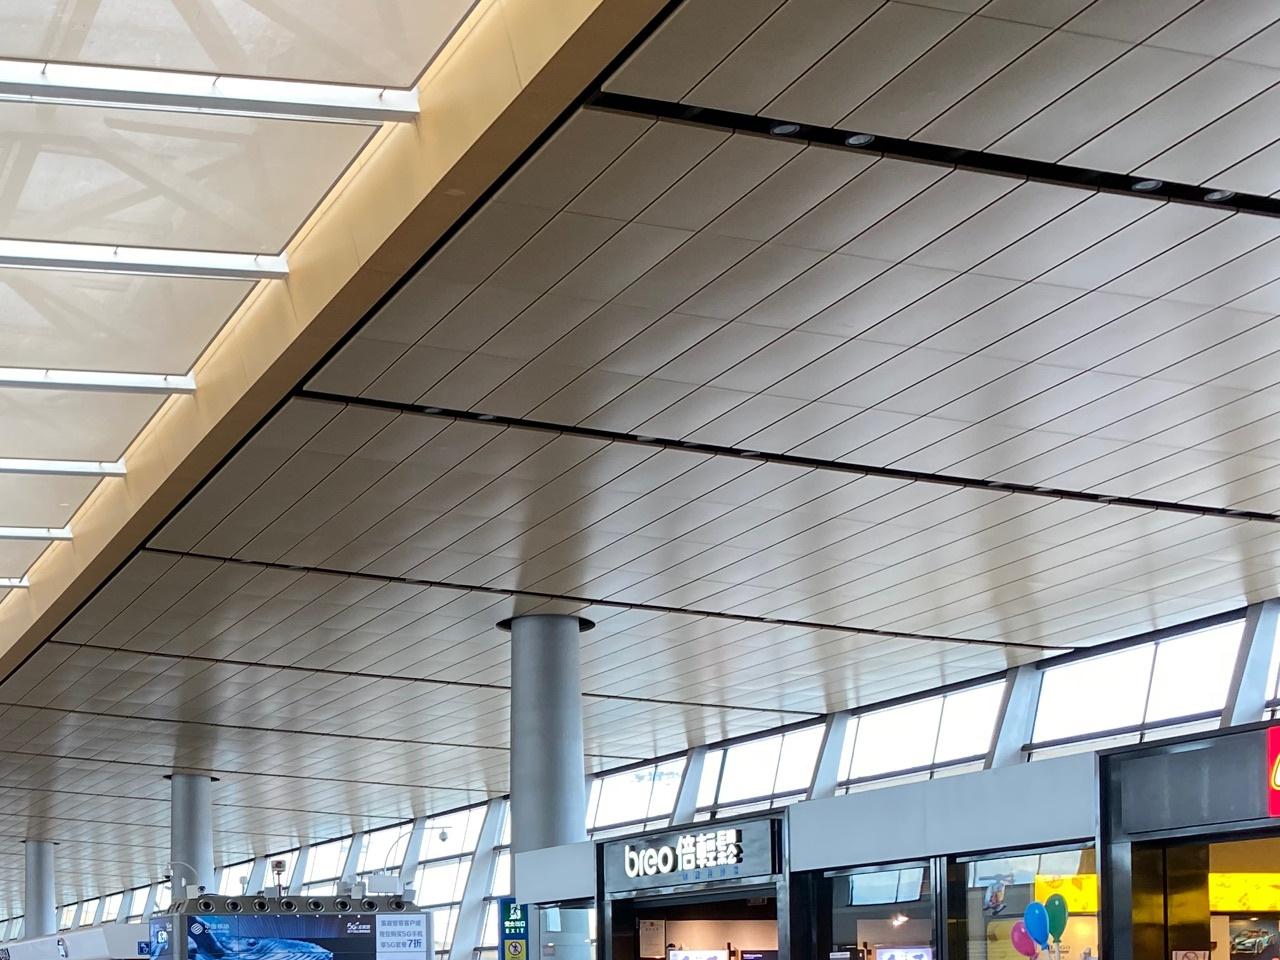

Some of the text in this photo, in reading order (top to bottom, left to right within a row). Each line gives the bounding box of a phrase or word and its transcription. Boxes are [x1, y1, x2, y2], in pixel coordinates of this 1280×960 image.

[624, 828, 738, 878] breo 倍輕鬆
